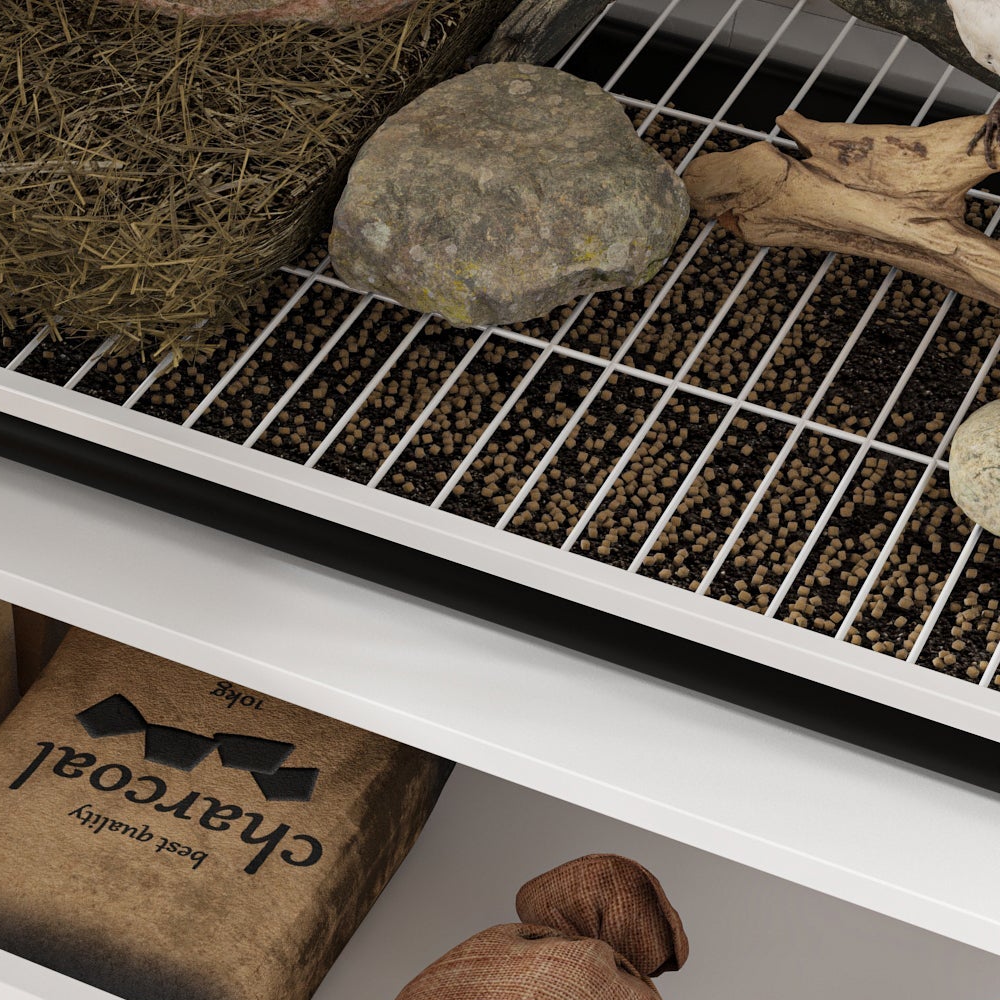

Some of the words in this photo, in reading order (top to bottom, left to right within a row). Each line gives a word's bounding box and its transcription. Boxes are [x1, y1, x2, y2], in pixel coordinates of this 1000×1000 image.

[210, 681, 264, 711] 10kg
[9, 741, 323, 875] charcoal
[67, 804, 153, 844] quality
[150, 836, 208, 871] best
